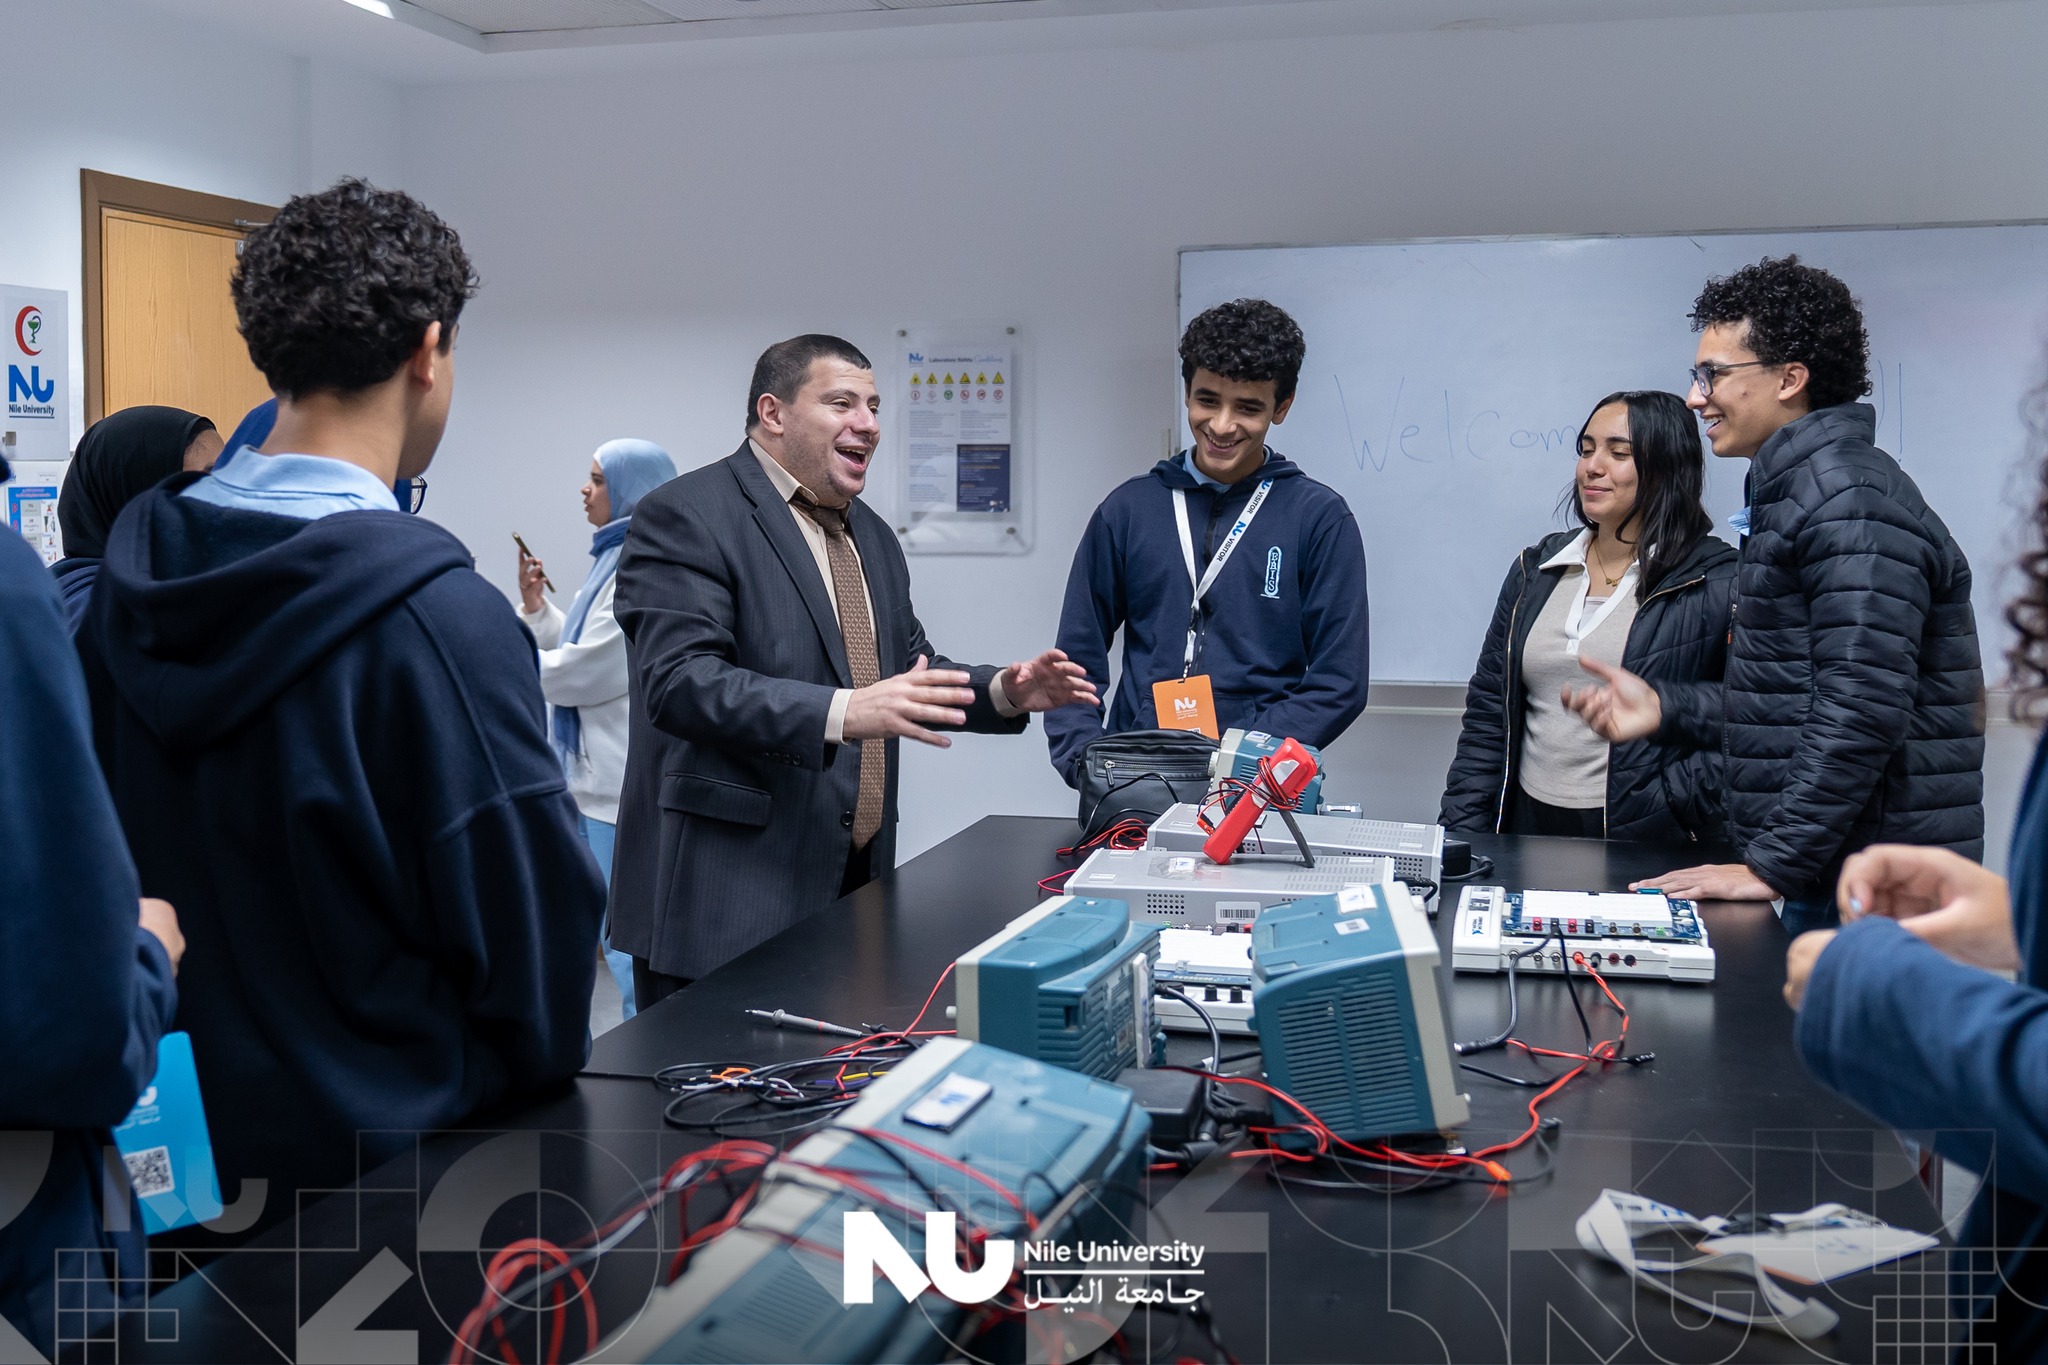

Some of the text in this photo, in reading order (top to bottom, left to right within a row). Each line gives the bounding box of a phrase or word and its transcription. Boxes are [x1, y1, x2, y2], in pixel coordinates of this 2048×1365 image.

[8, 364, 55, 404] NU
[8, 404, 55, 417] Nile University
[1247, 491, 1265, 515] VISITOR
[1231, 520, 1247, 537] NU
[1216, 537, 1235, 562] VISITOR
[1173, 697, 1197, 711] NU
